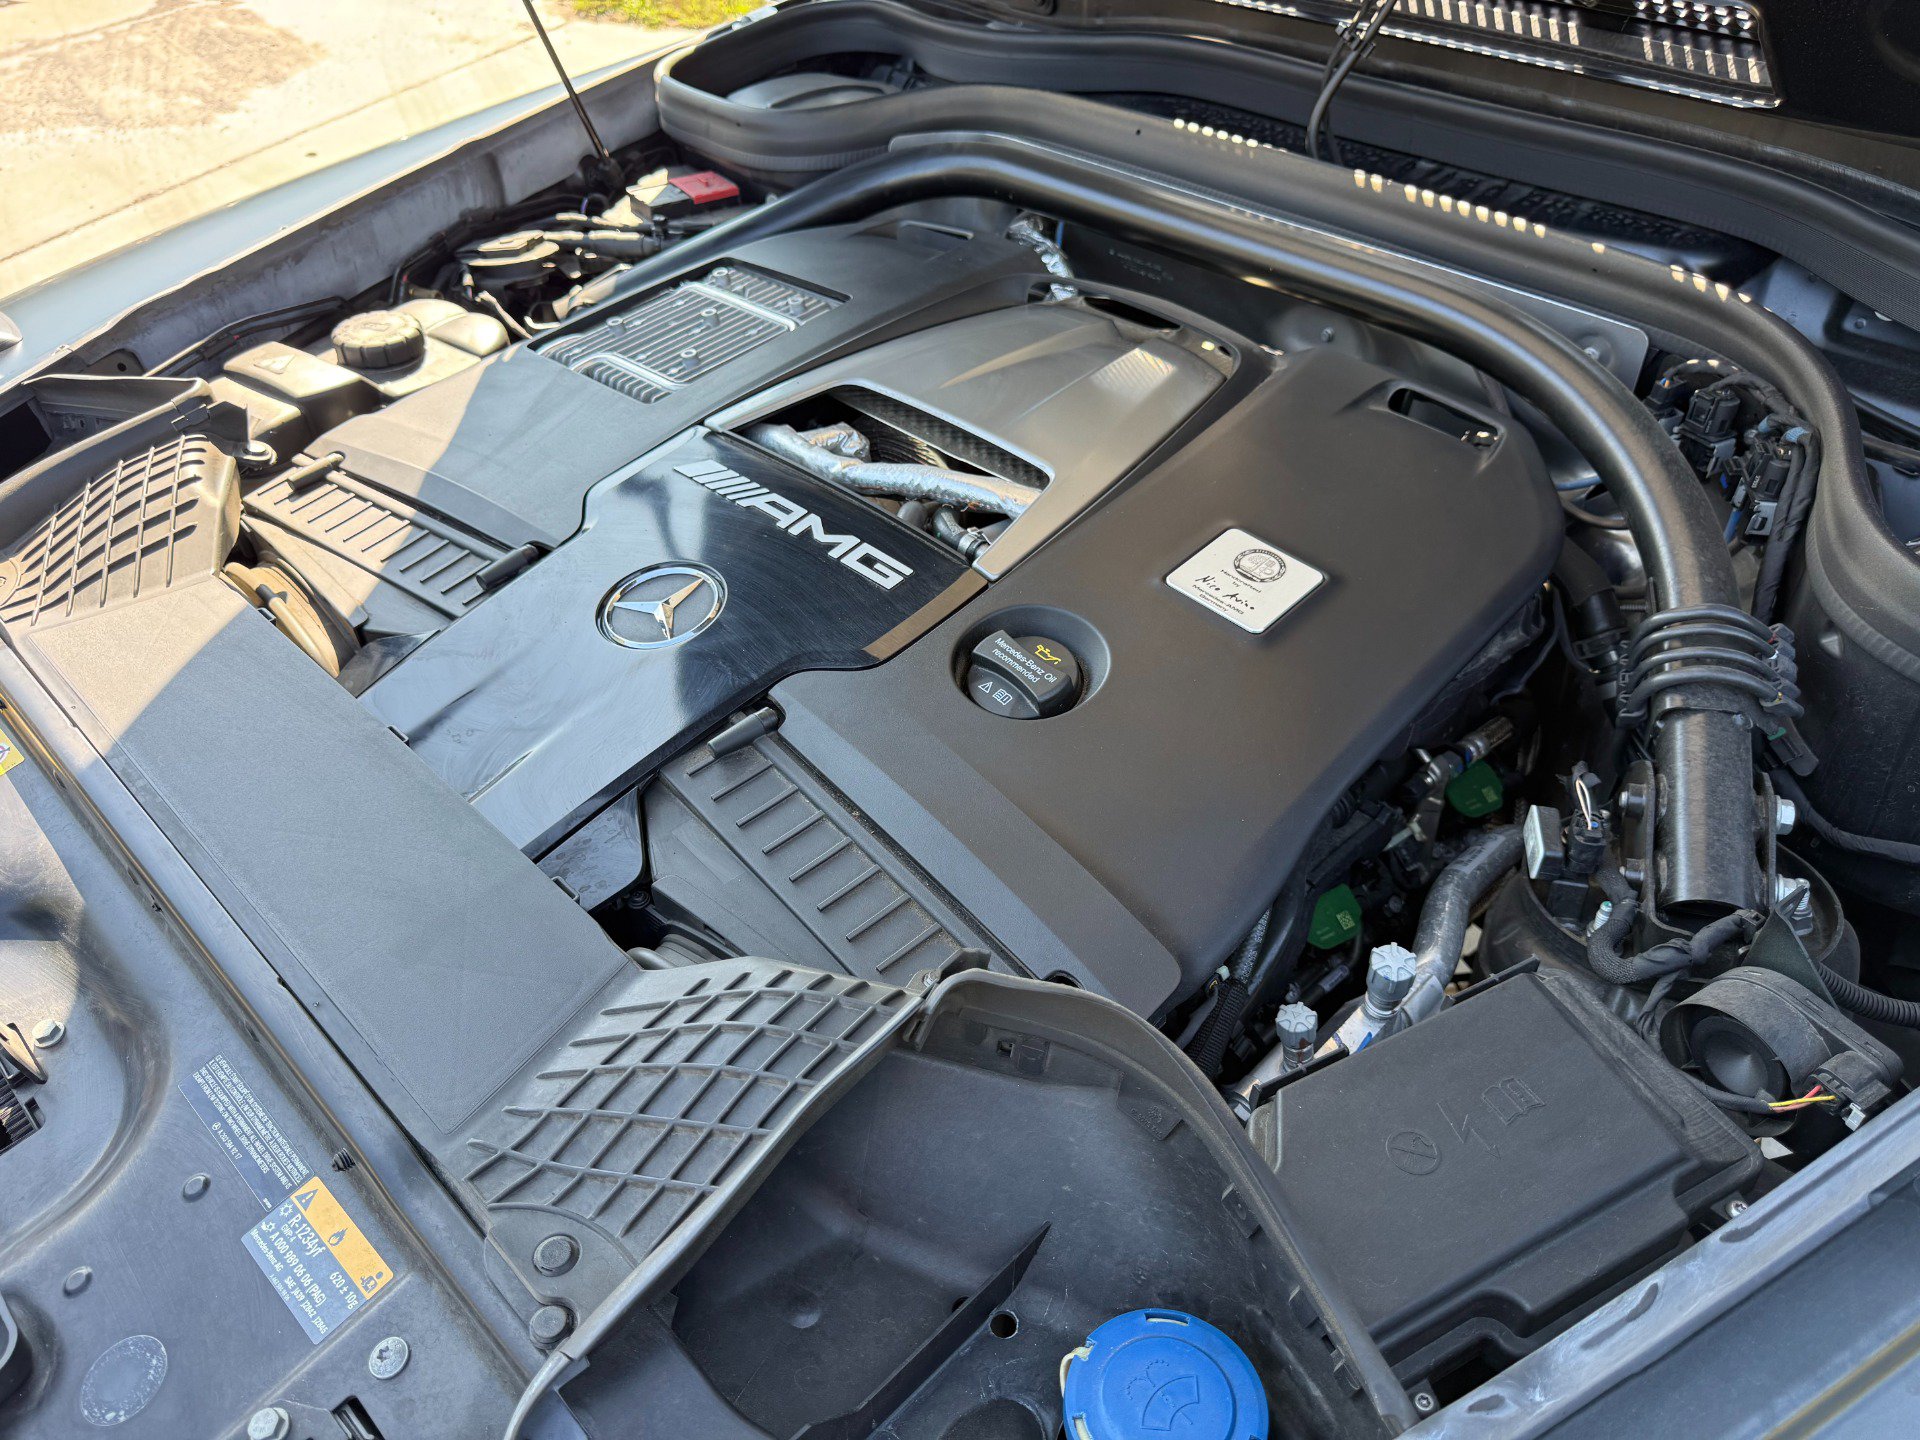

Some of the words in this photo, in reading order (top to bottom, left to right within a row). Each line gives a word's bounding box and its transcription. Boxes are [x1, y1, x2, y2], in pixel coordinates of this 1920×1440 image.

[1220, 569, 1261, 593] Handcrafted
[1192, 584, 1244, 615] Mercedes-AMG
[1199, 593, 1228, 612] Germany
[992, 648, 1041, 683] recommended
[994, 637, 1045, 676] Mercedes-Benz
[1044, 673, 1057, 684] Oil
[269, 1231, 280, 1242] A
[274, 1237, 289, 1253] 000
[285, 1213, 326, 1257] R-1234yf
[250, 1229, 277, 1265] Mercedes-Benz
[274, 1262, 284, 1272] AG
[284, 1276, 296, 1289] SAE
[290, 1287, 305, 1301] J639
[284, 1250, 299, 1267] 989
[293, 1264, 306, 1277] 06
[300, 1273, 313, 1287] 06
[330, 1271, 345, 1288] 620
[345, 1291, 358, 1310] 10g
[305, 1283, 326, 1307] (PAG)
